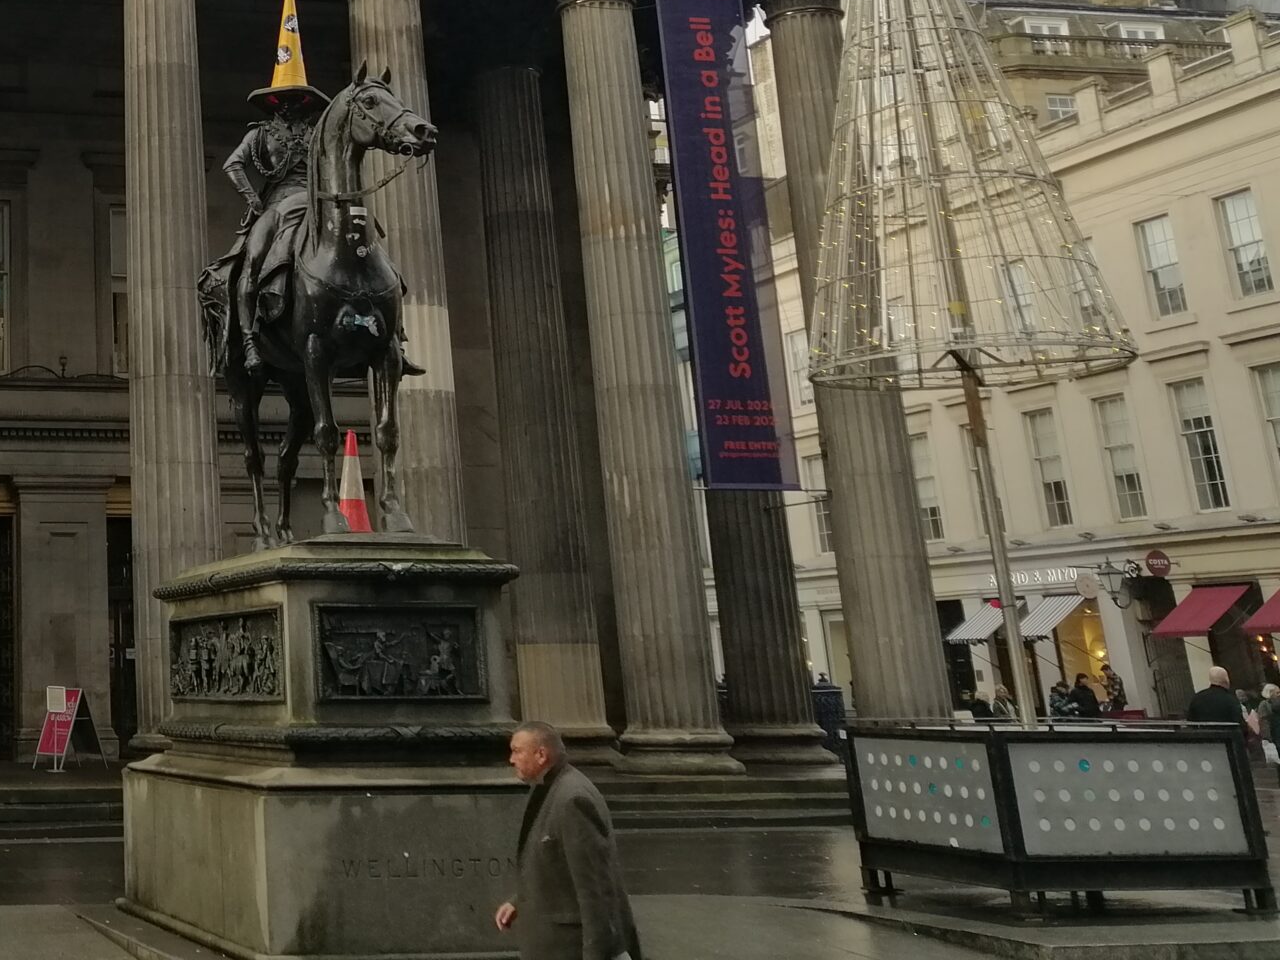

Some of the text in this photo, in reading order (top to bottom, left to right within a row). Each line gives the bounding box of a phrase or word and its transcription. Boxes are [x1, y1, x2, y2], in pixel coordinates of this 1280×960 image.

[689, 17, 752, 379] Scott Myles: Head in a Bell
[1148, 558, 1169, 566] COSTA
[1033, 569, 1042, 584] &
[1047, 567, 1078, 582] MIYU
[341, 856, 523, 880] WELLINGTON
